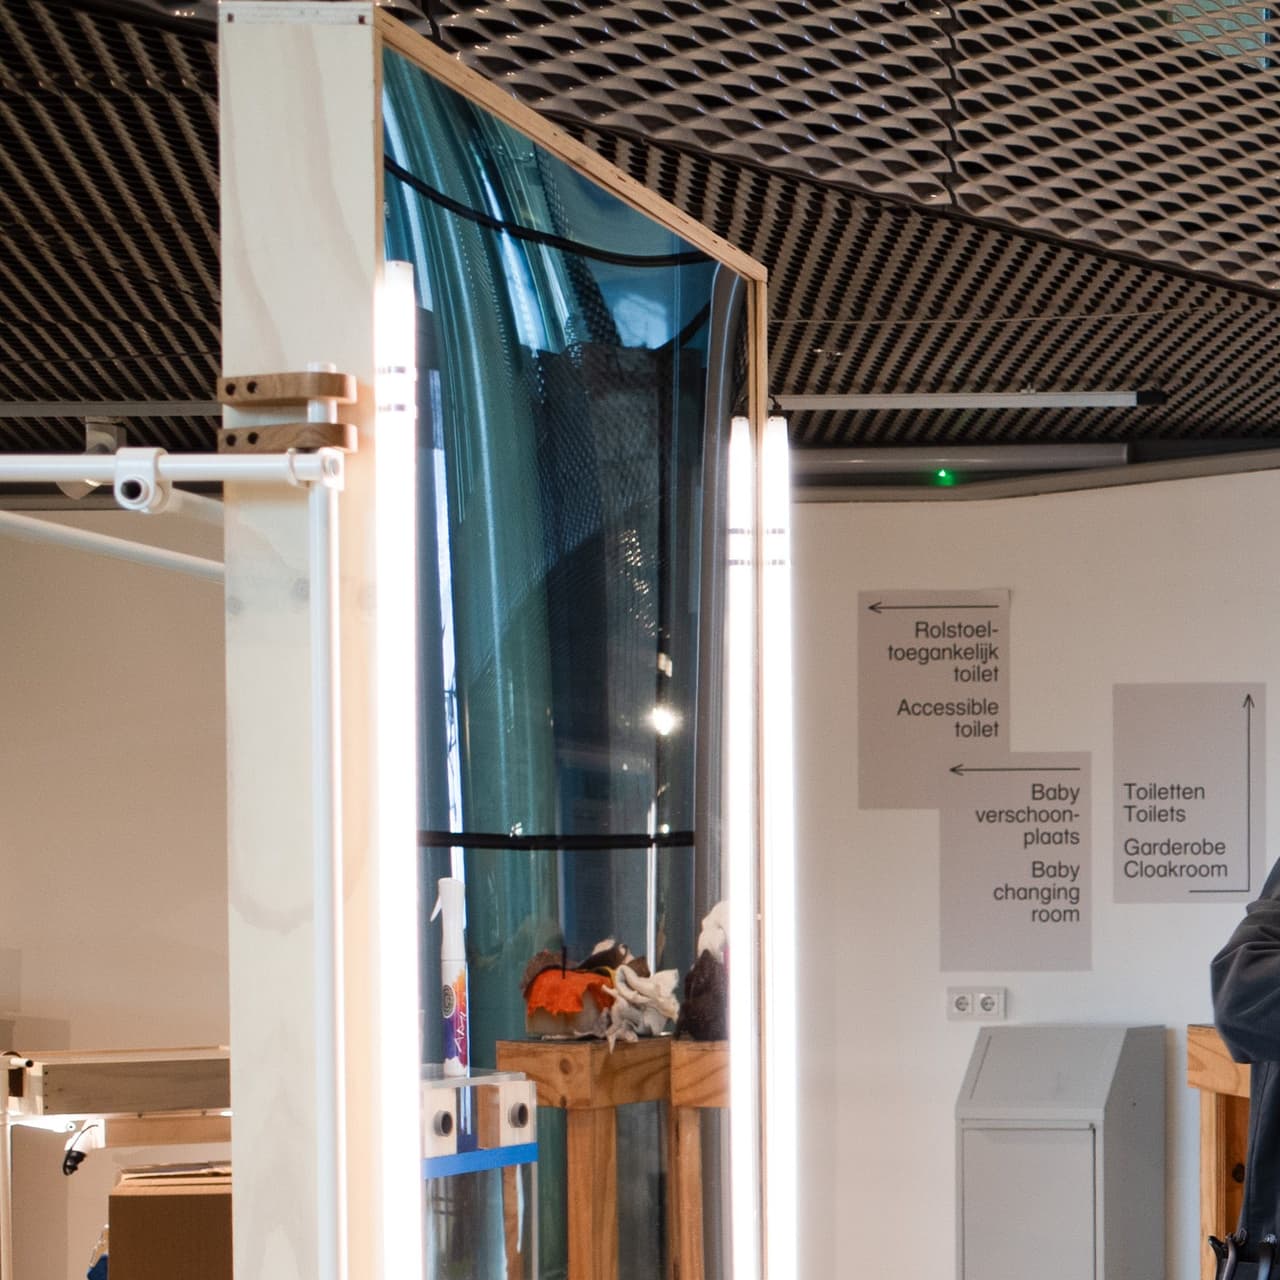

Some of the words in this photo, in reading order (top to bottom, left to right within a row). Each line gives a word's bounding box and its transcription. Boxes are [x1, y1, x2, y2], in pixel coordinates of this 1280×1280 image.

[915, 621, 998, 639] Rolstoel-
[888, 643, 999, 665] toegankelijk
[954, 663, 999, 682] toilet
[897, 698, 999, 716] Accessible
[955, 720, 999, 738] toilet
[1032, 783, 1080, 803] Baby
[1123, 783, 1205, 800] Toiletten
[975, 804, 1080, 823] verschoon-
[1123, 805, 1186, 822] Toilets
[1024, 827, 1080, 849] plaats
[1124, 838, 1226, 856] Garderobe
[1032, 861, 1080, 880] Baby
[1124, 860, 1228, 878] Cloakroom
[993, 881, 1080, 904] changing
[1032, 909, 1080, 923] room
